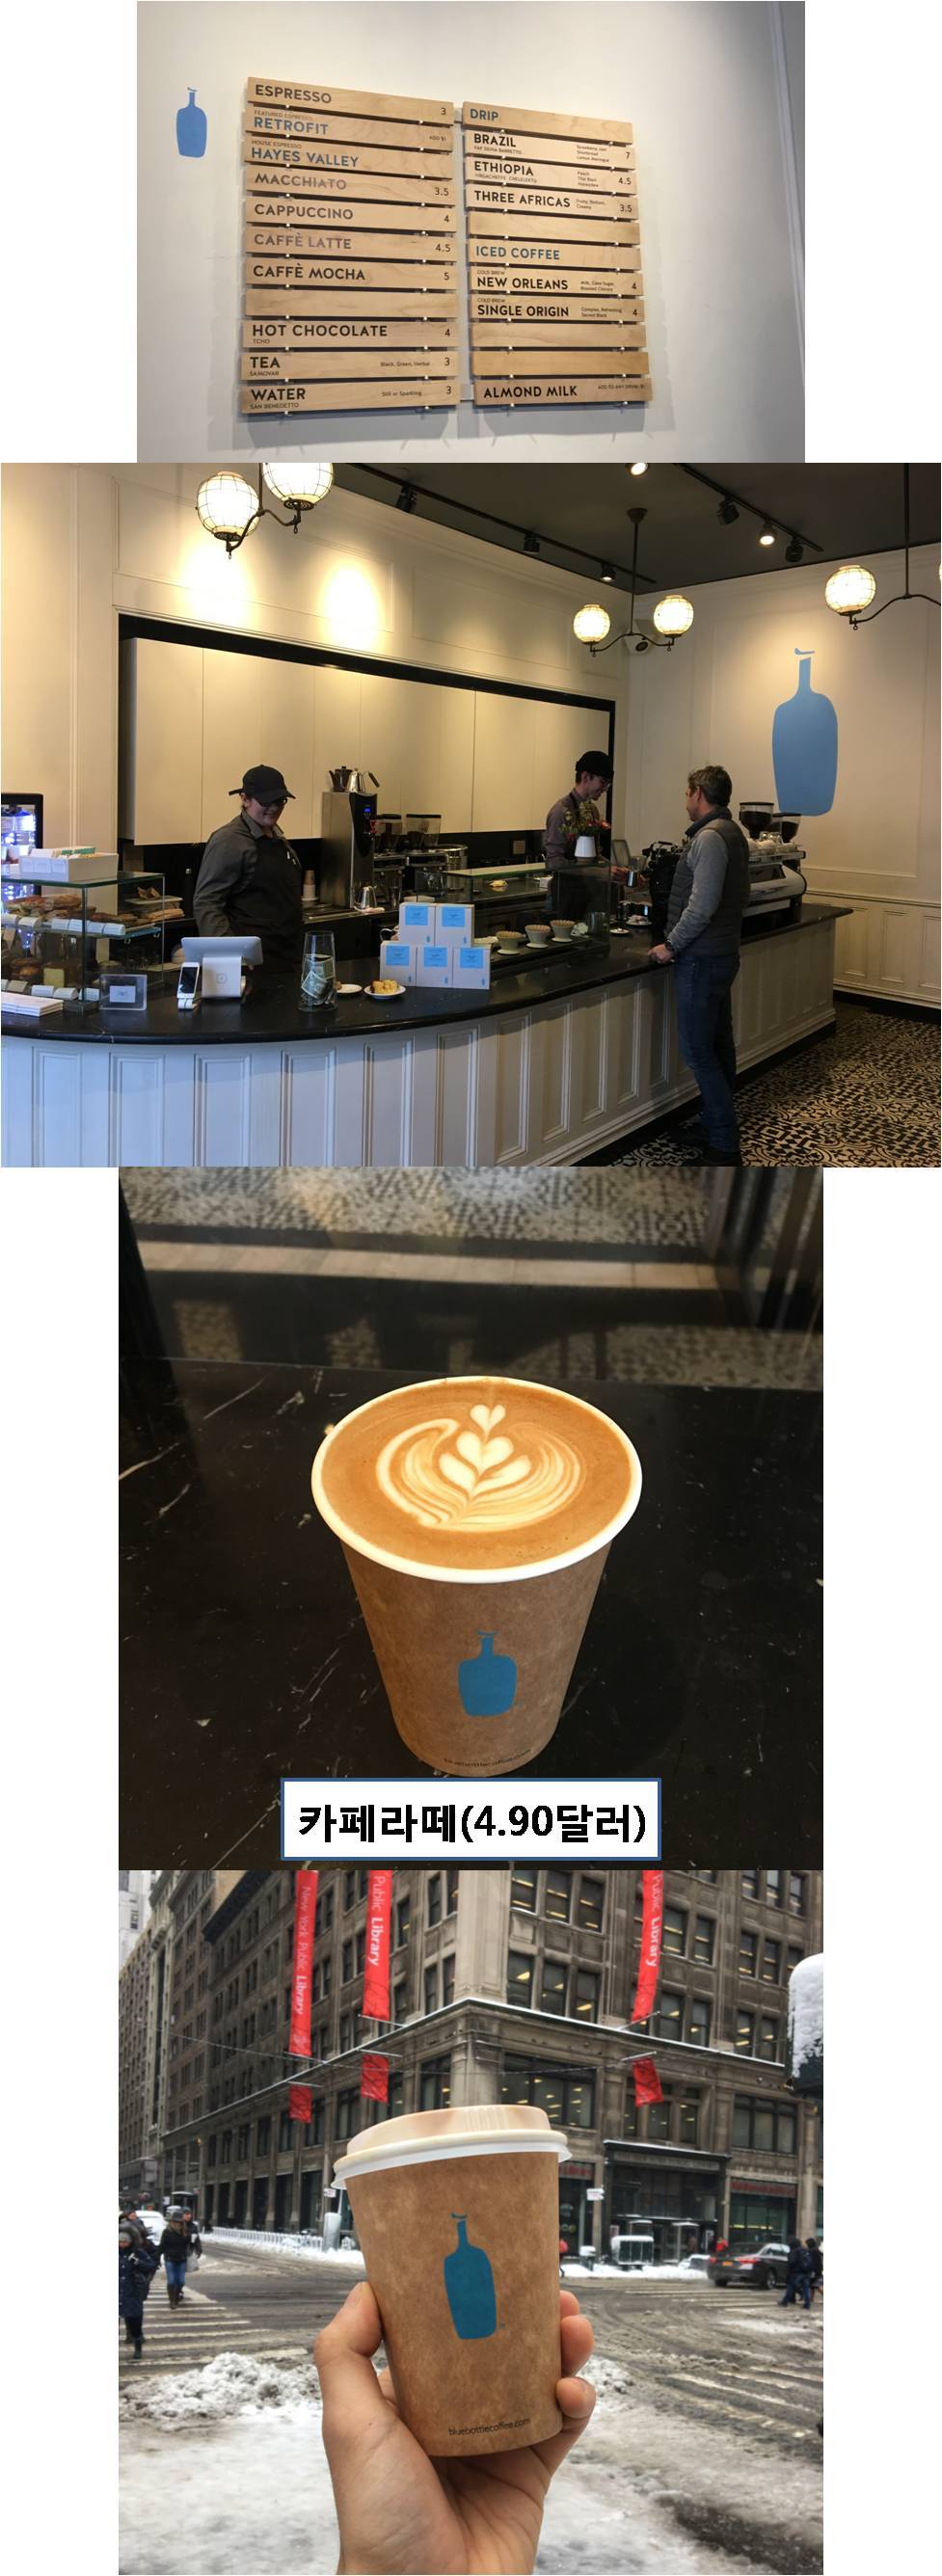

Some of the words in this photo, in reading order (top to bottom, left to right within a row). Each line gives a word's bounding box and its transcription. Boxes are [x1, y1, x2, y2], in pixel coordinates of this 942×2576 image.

[255, 84, 332, 104] ESPRESSO
[470, 108, 499, 121] DRIP
[254, 117, 328, 134] RETROFIT
[473, 133, 517, 148] BRAZIL
[251, 147, 300, 162] HAYES
[306, 152, 359, 168] VALLEY
[626, 151, 631, 160] 7
[474, 160, 534, 176] ETHIOPIA
[255, 173, 347, 190] MACCHIATO
[618, 176, 632, 185] 4.5
[434, 187, 450, 197] 3.5
[474, 190, 515, 203] THREE
[519, 194, 571, 208] AFRICAS
[254, 204, 354, 220] CAPPUCCINO
[619, 203, 632, 213] 3.5
[444, 215, 450, 223] 4
[254, 232, 303, 247] CAFFÈ
[308, 236, 352, 250] LATTE
[435, 243, 451, 253] 4.5
[476, 245, 507, 257] ICED
[511, 247, 560, 260] COFFEE
[253, 263, 304, 278] CAFFÈ
[309, 268, 366, 281] MOCHA
[444, 272, 450, 281] 5
[477, 277, 508, 287] NEW
[512, 278, 568, 290] ORLEANS
[477, 304, 522, 316] SINGLE
[526, 306, 569, 317] ORIGIN
[632, 308, 638, 317] 4
[252, 324, 287, 336] HOT
[292, 324, 388, 337] CHOCOLATE
[444, 329, 451, 337] 4
[250, 357, 281, 369] TEA
[444, 357, 450, 366] 3
[251, 388, 306, 401] WATER
[446, 385, 452, 395] 3
[484, 387, 542, 398] ALMOND
[546, 386, 578, 397] MILK
[301, 1886, 311, 1911] New
[372, 1875, 386, 1911] Public
[367, 1917, 383, 1966] Library
[645, 1916, 660, 1967] Library
[296, 1942, 309, 1971] Public
[294, 1975, 308, 2015] Library
